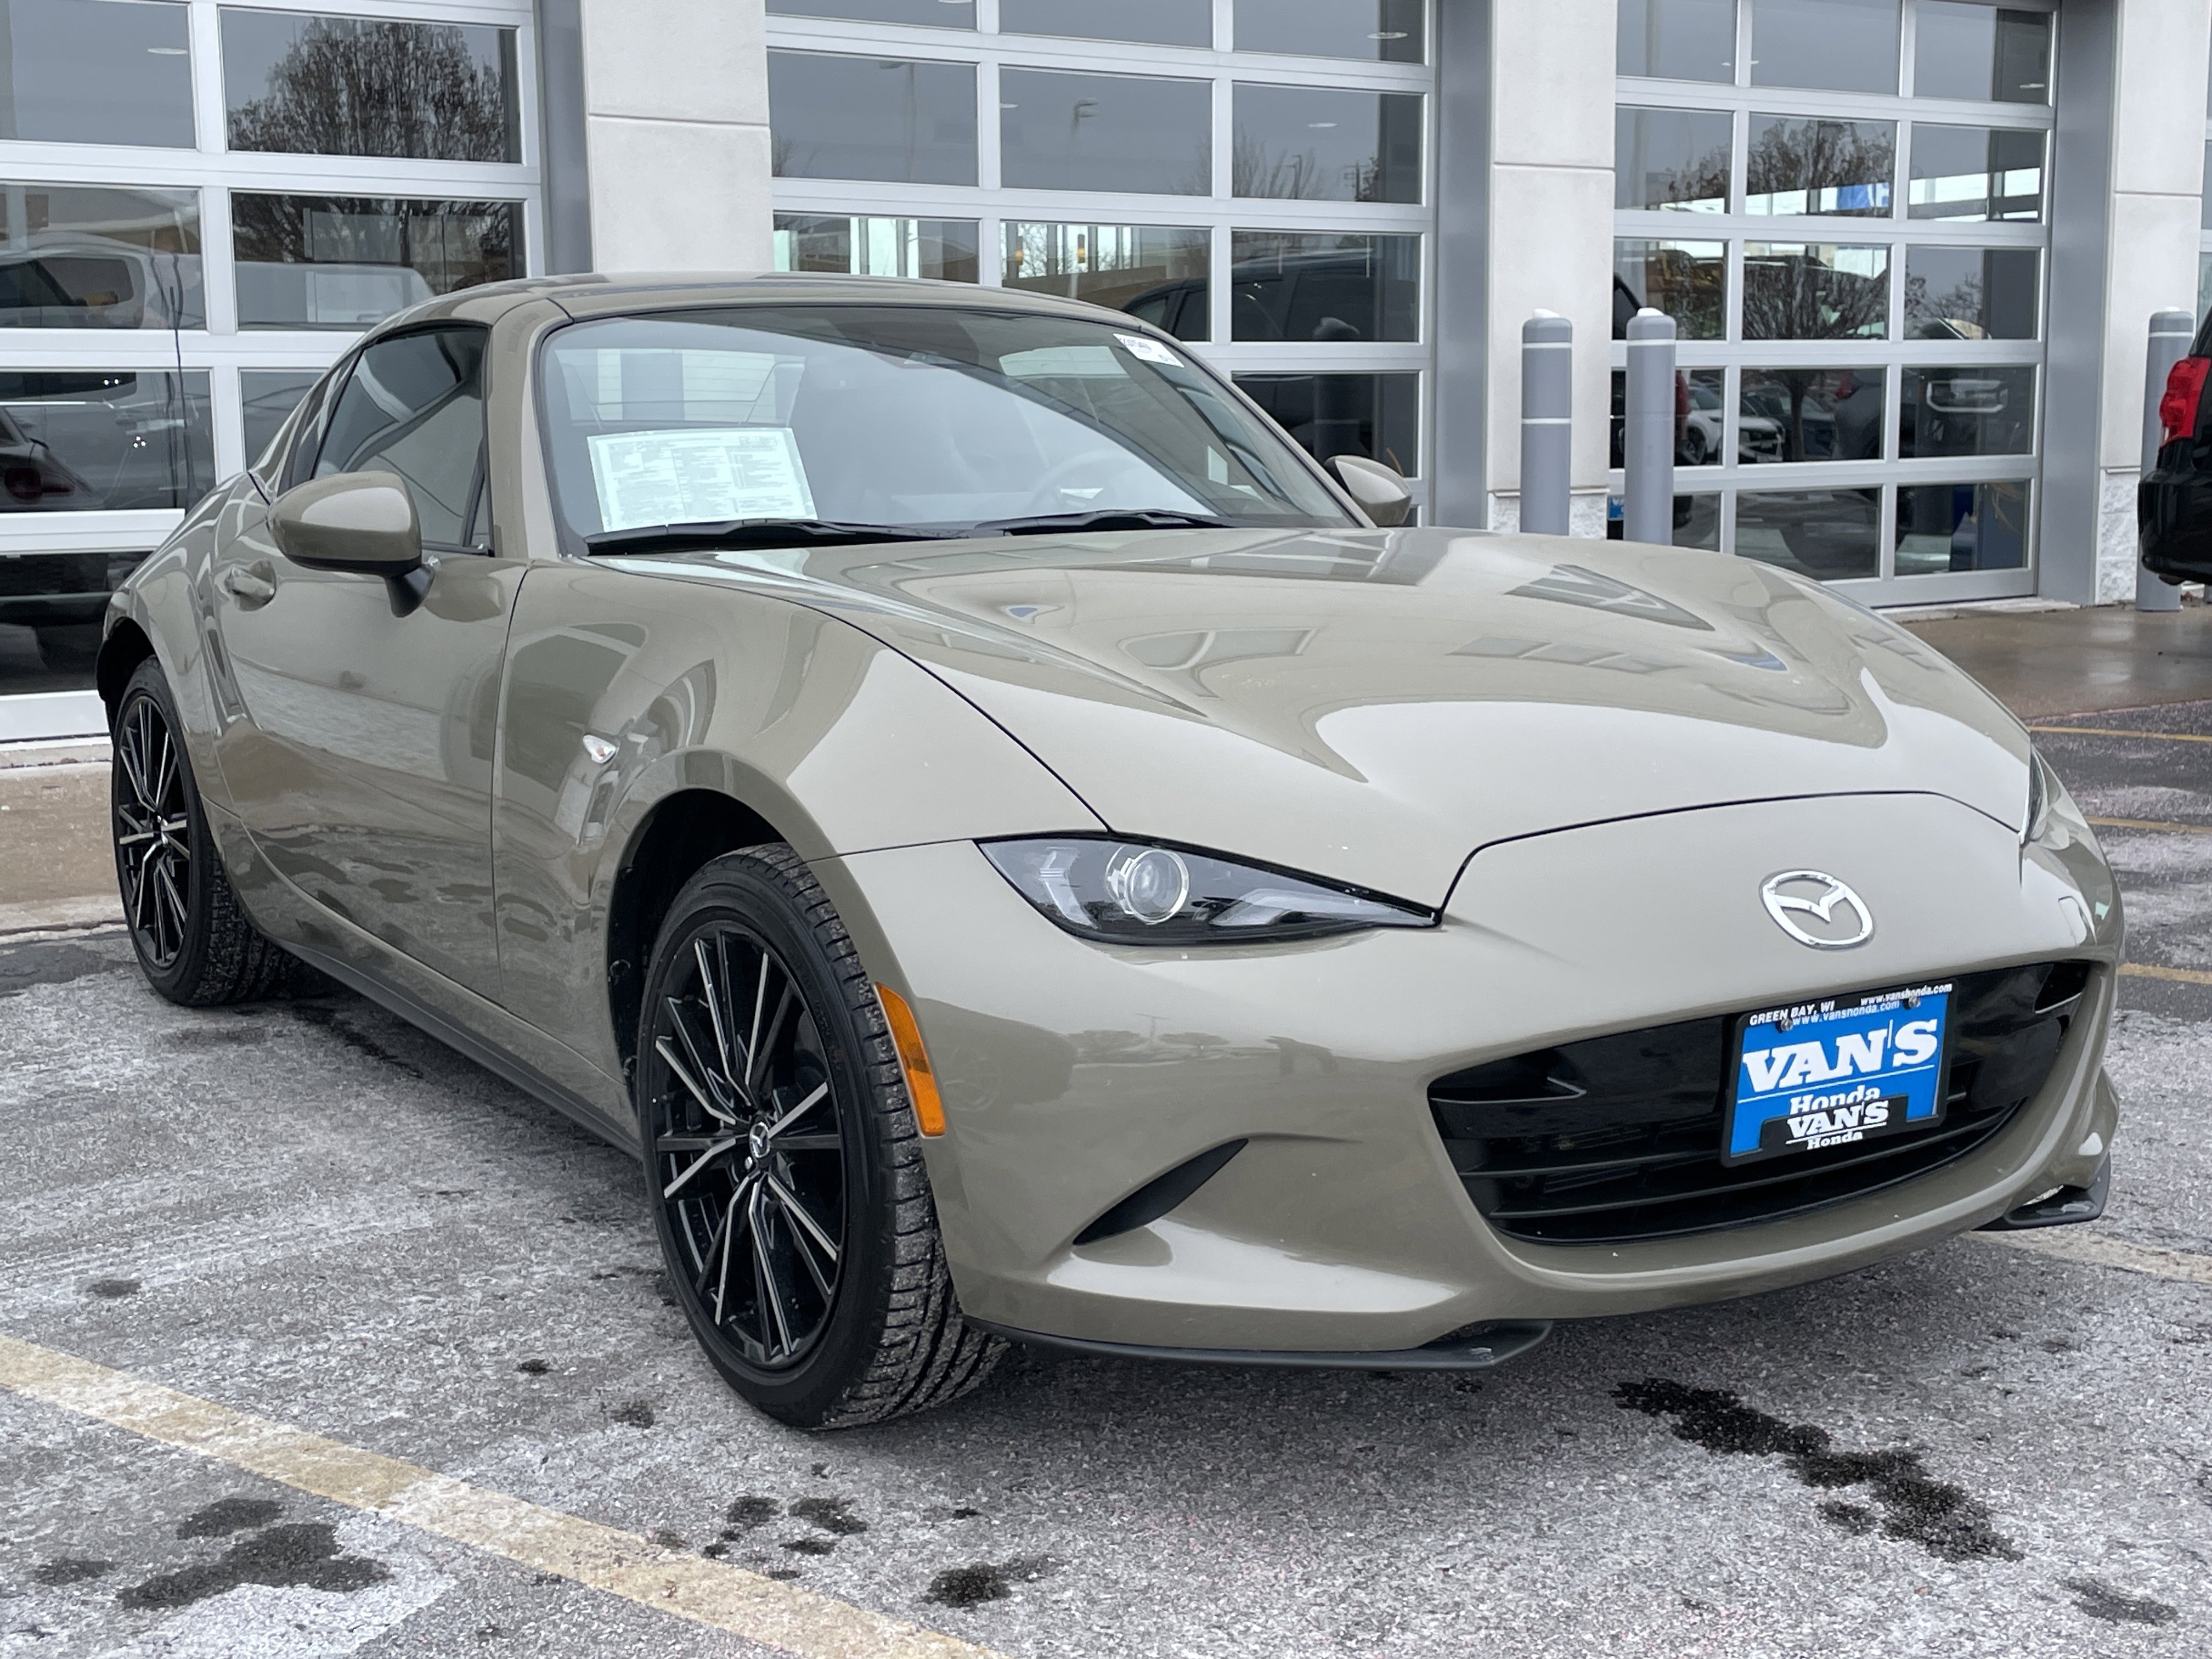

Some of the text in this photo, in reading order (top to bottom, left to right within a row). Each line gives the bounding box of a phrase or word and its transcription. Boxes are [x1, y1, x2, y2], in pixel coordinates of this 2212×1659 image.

[1860, 983, 1953, 1006] www.vanshonda.com
[1750, 1000, 1835, 1026] GREEN BAY, WI
[1742, 1018, 1937, 1092] VAN'S
[1790, 1085, 1881, 1115] Honda
[1787, 1101, 1889, 1138] VAN'S
[1807, 1131, 1863, 1150] Honda
